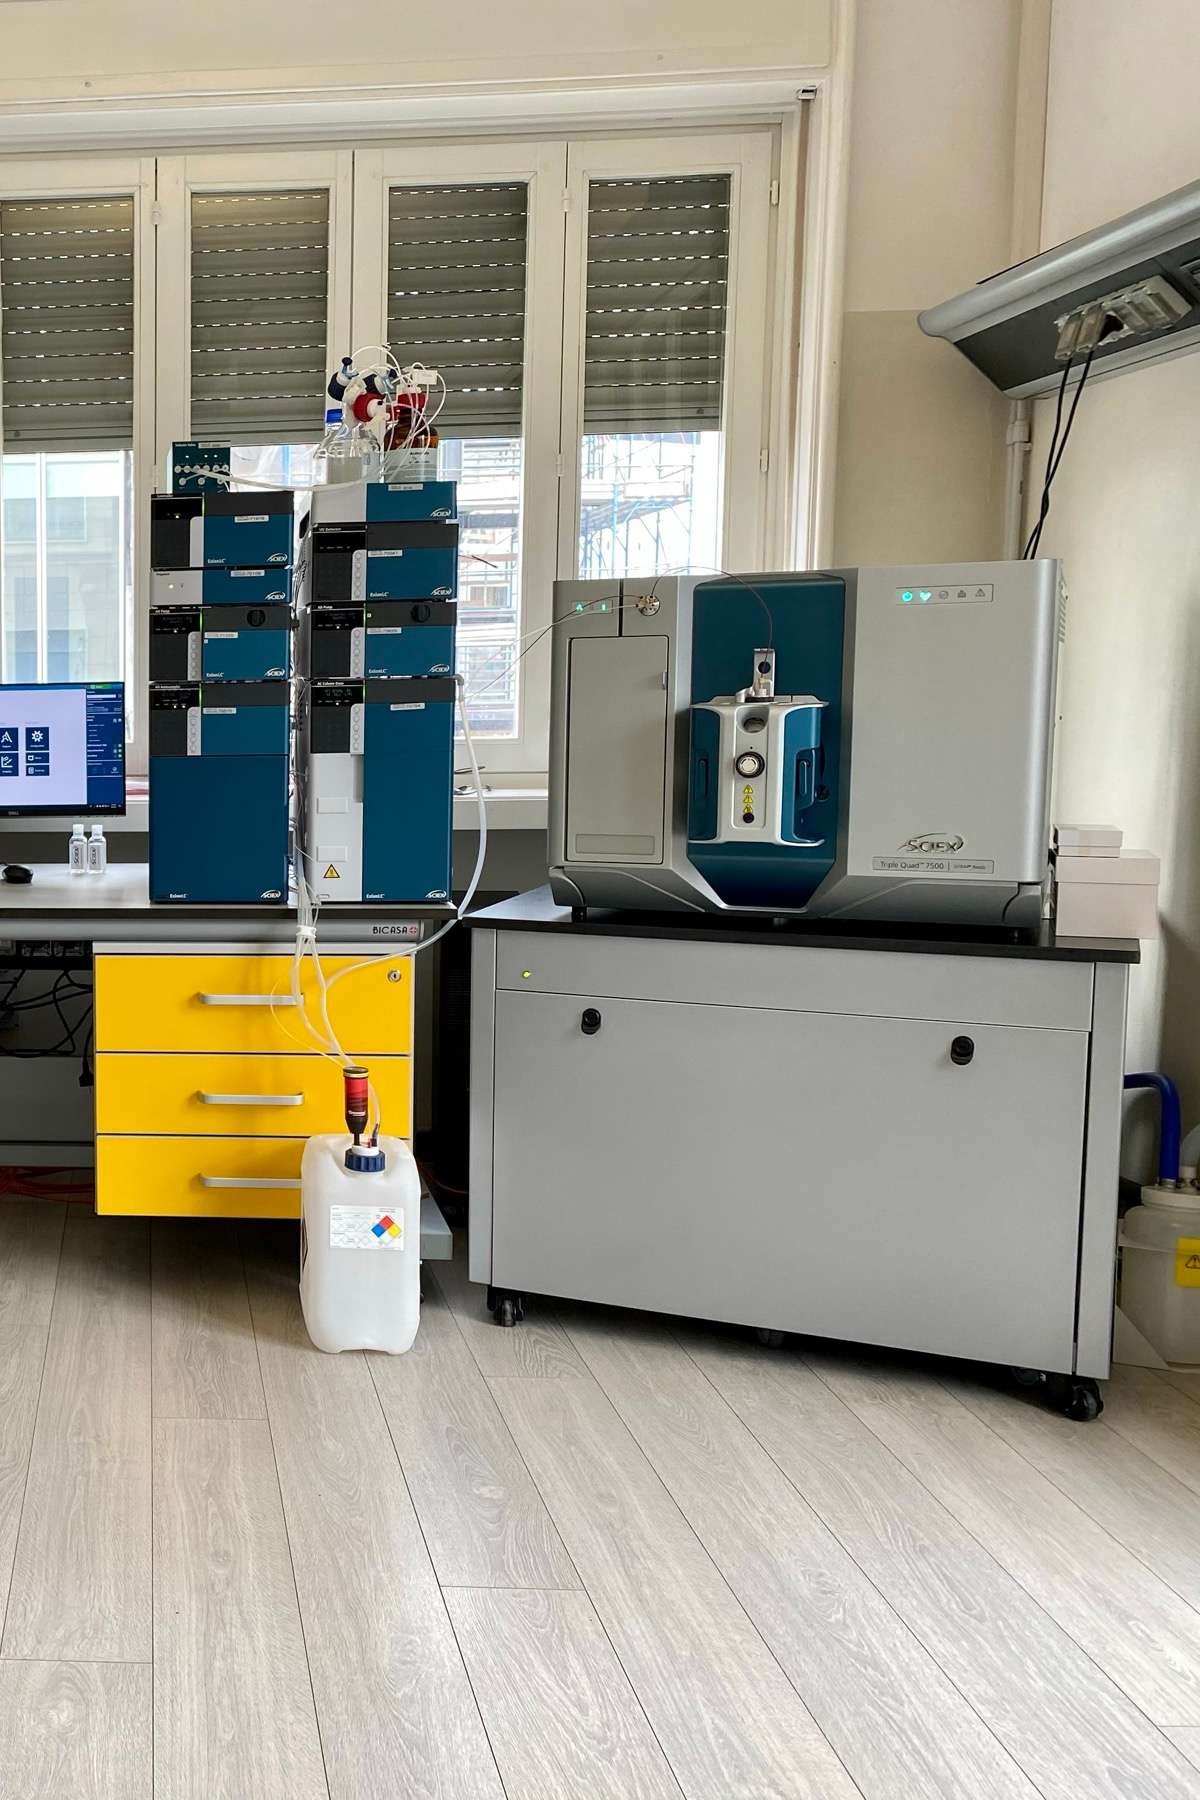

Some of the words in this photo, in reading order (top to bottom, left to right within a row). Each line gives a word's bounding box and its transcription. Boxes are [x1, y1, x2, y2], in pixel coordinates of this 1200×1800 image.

[904, 839, 960, 853] SCIEX
[880, 861, 898, 869] Triple
[372, 926, 408, 934] BICASA
